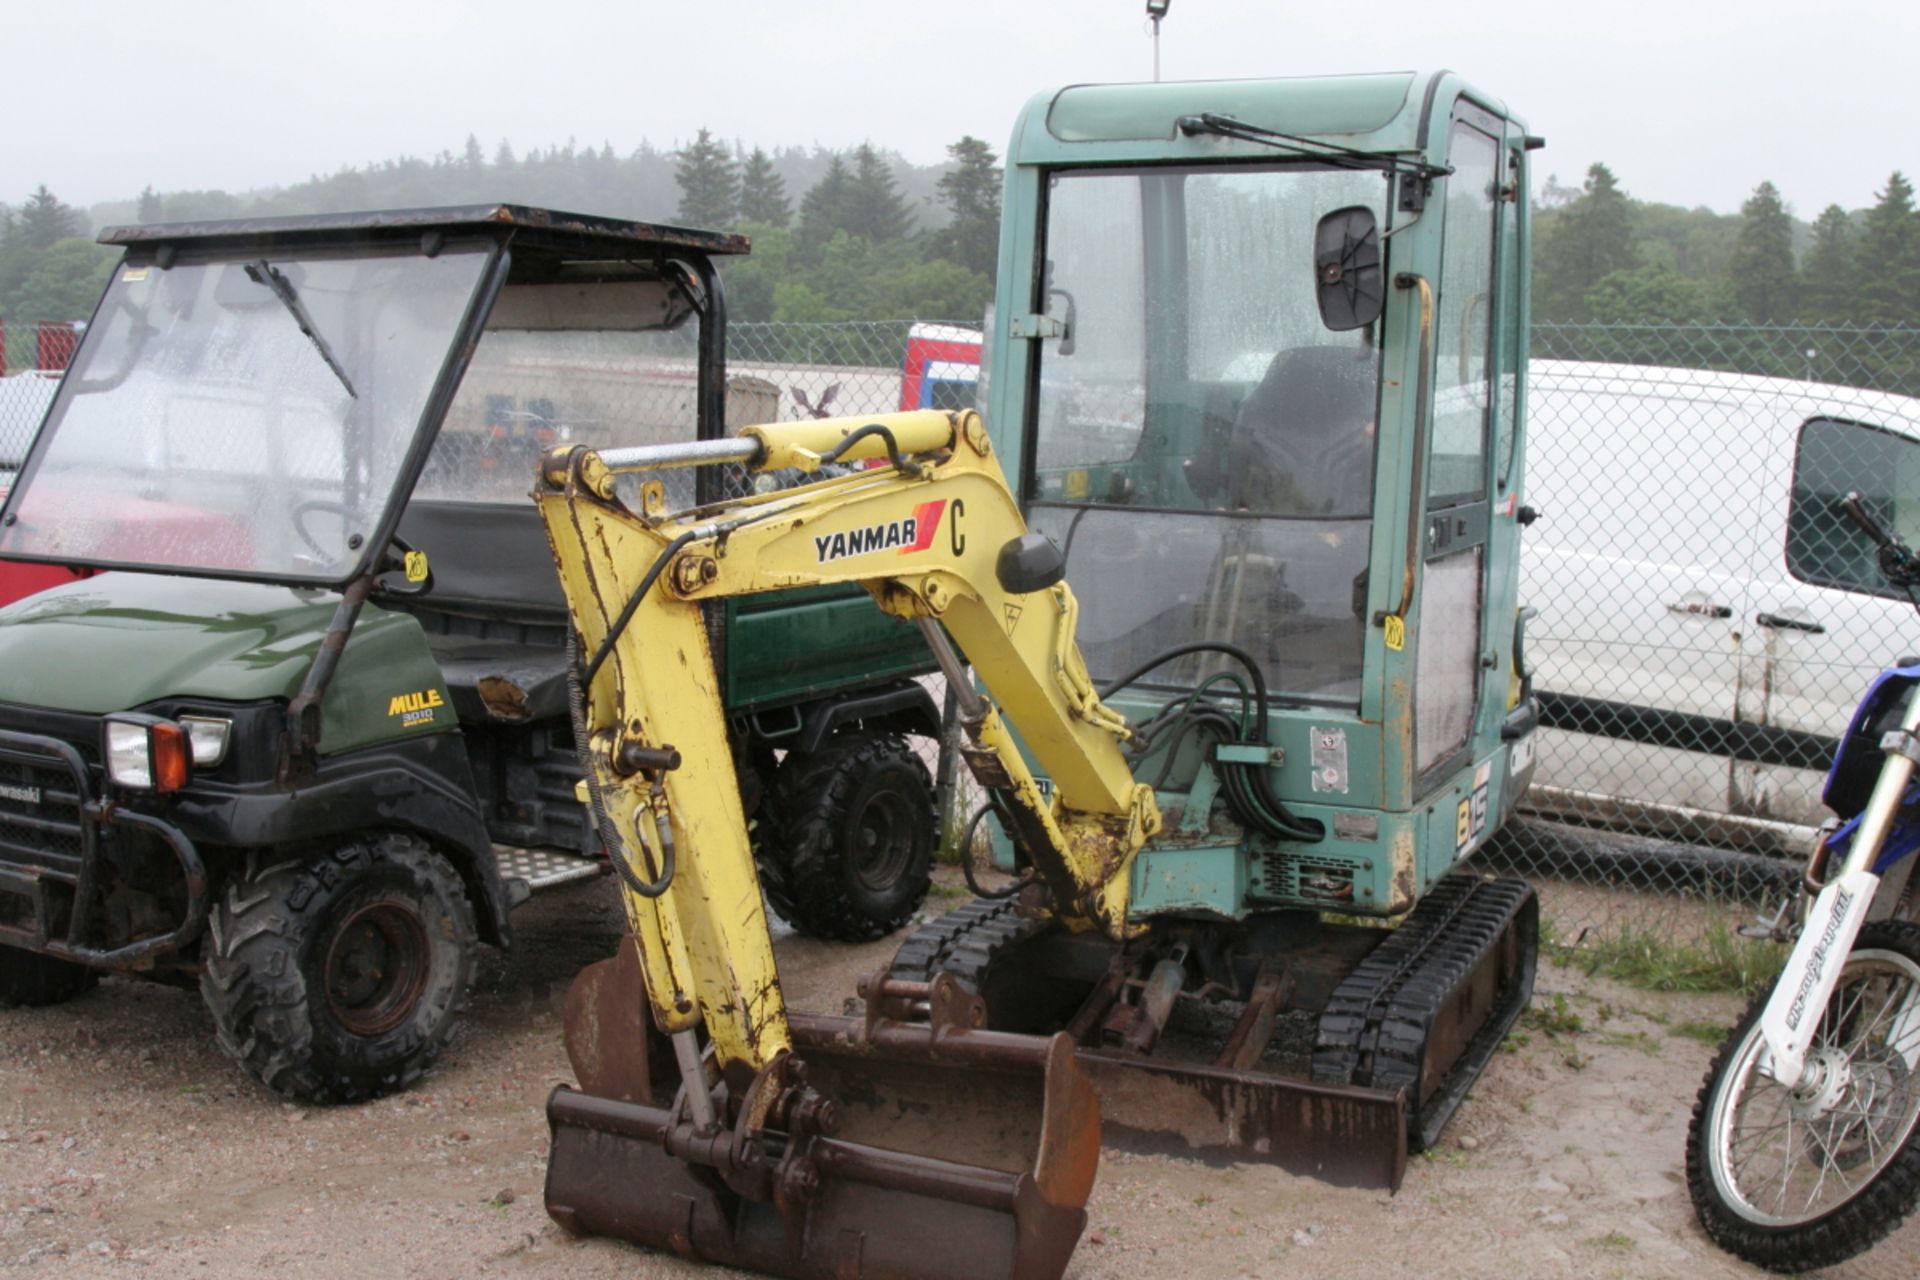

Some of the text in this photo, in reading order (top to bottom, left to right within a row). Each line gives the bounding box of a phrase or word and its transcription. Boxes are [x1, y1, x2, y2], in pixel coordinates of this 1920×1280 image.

[815, 518, 917, 563] YANMAR
[950, 498, 965, 557] C
[388, 689, 444, 716] MULE
